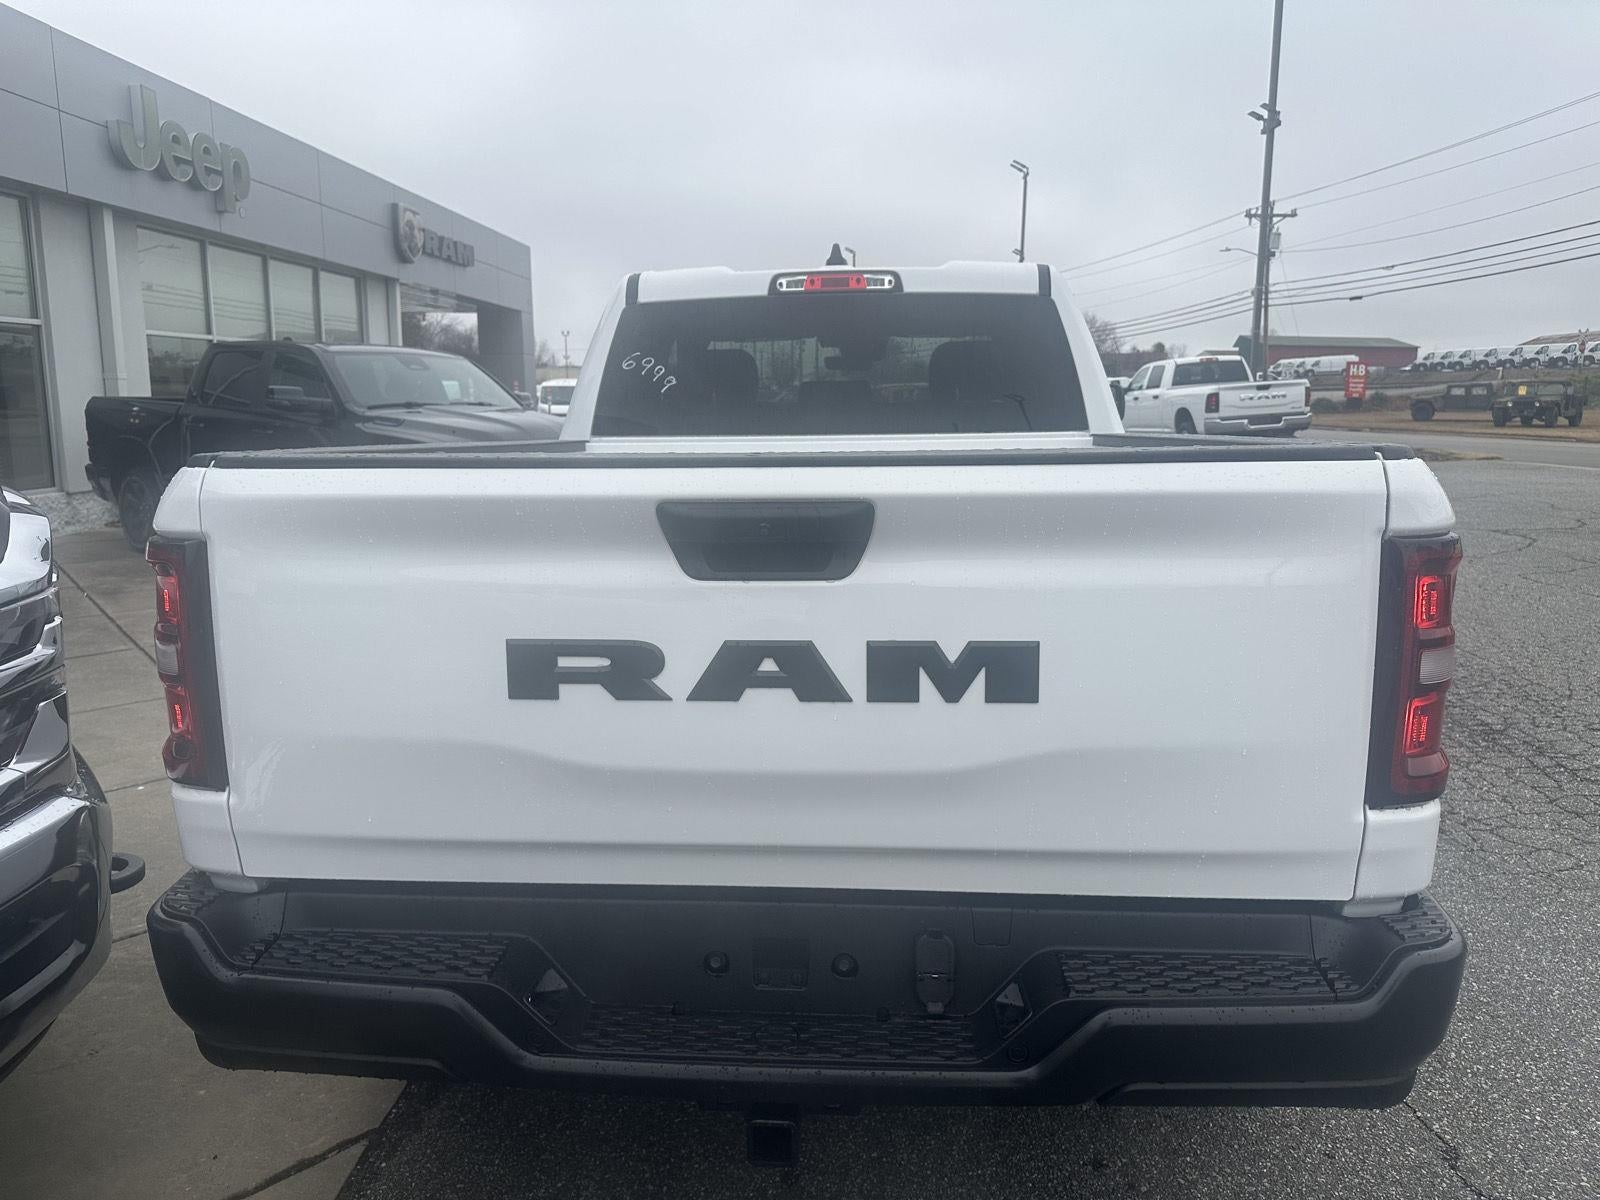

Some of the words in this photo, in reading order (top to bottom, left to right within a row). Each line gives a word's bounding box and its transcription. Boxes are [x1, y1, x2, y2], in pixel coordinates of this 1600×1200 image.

[107, 84, 250, 214] Jeep
[423, 228, 474, 267] RAM
[622, 352, 677, 393] 6999
[506, 639, 1040, 703] RAM
